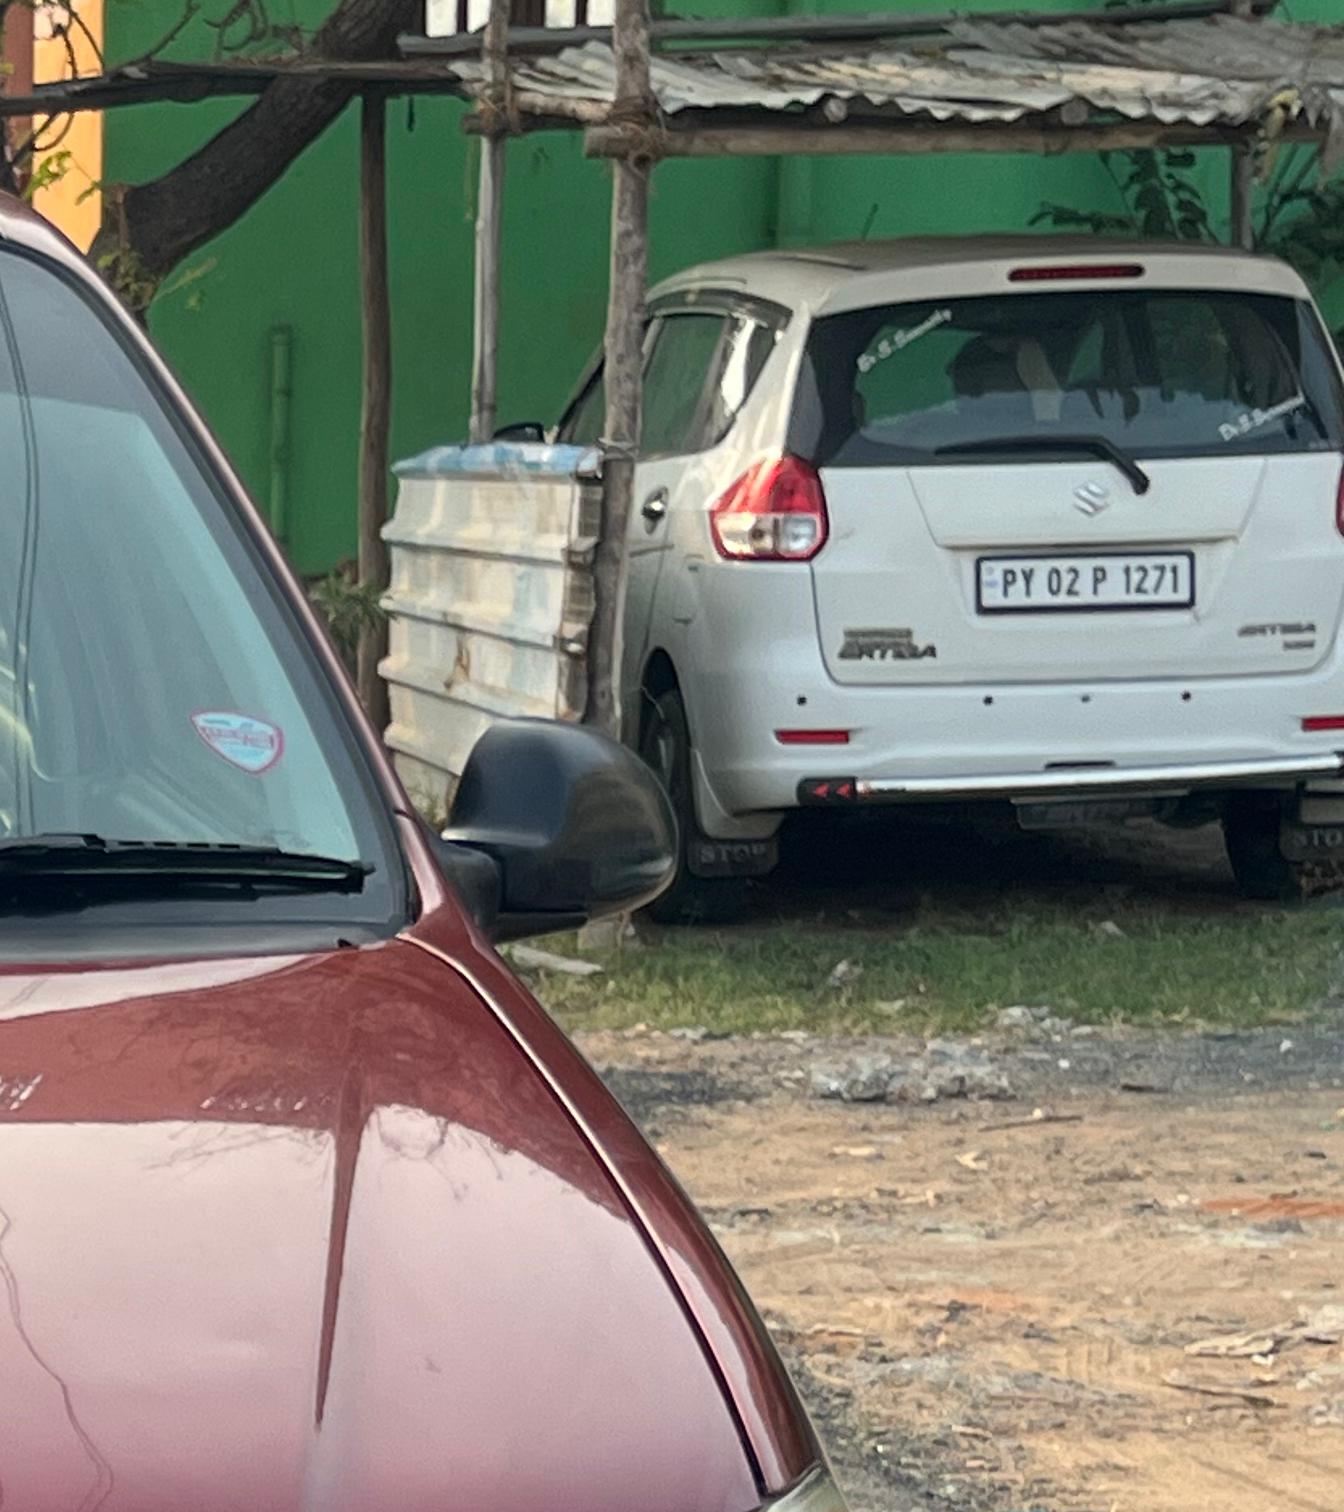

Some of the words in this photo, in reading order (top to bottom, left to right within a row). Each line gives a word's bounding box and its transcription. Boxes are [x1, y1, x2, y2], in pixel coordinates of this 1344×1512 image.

[1002, 567, 1035, 598] PY
[1047, 566, 1081, 597] 02
[1091, 565, 1108, 596] P
[1123, 564, 1179, 595] 1271
